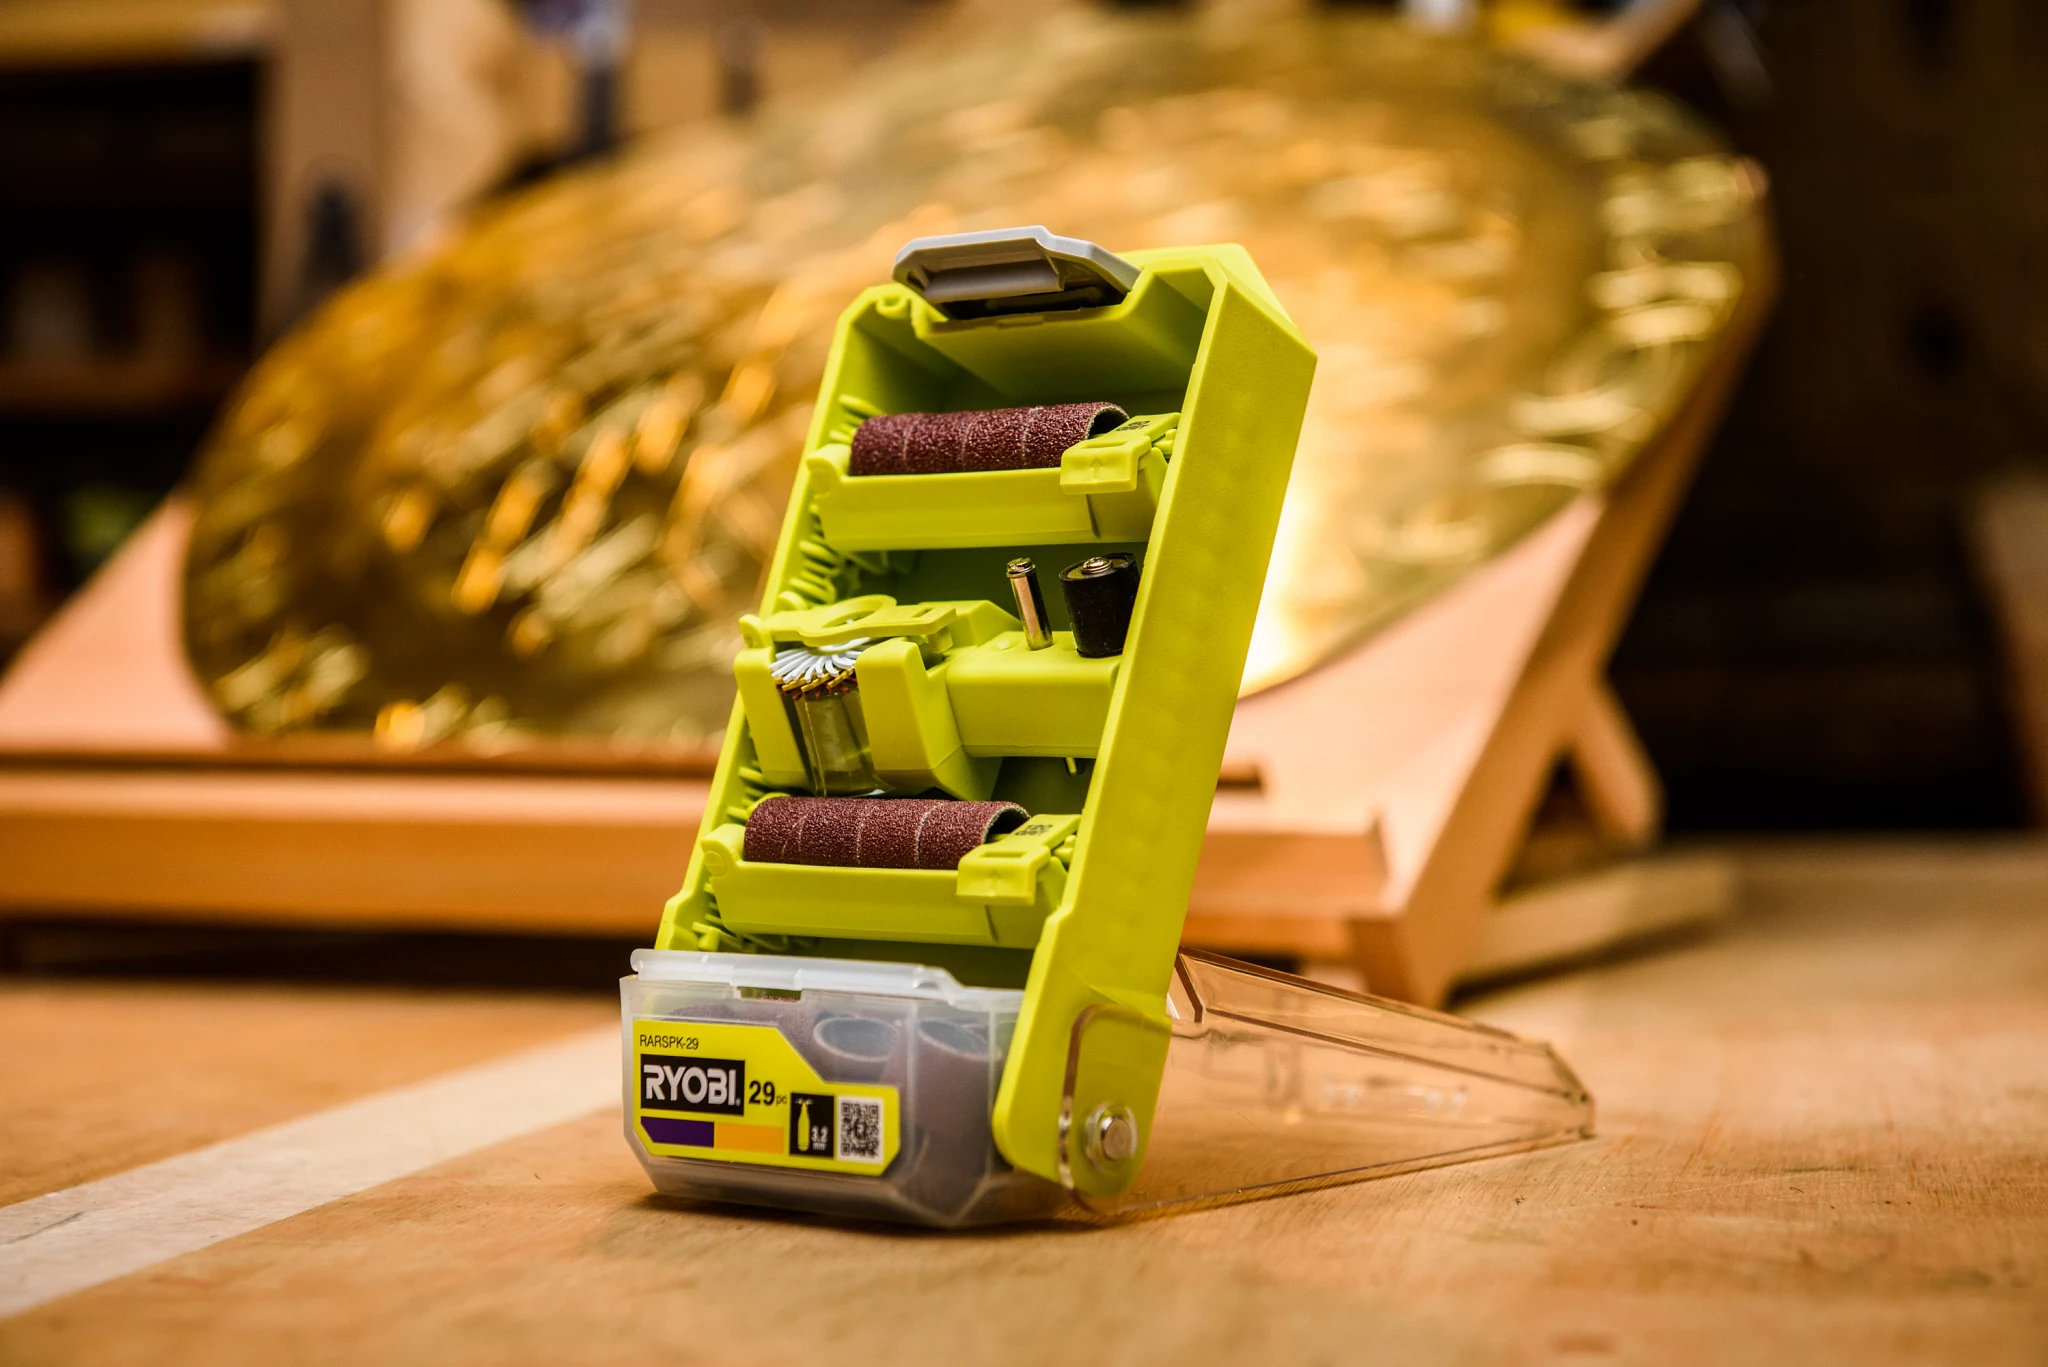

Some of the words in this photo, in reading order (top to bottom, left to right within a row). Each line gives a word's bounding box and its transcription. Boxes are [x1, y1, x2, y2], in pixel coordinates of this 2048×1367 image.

[640, 1034, 699, 1050] RARSPK-29
[643, 1064, 738, 1106] RYOBI
[811, 1125, 829, 1142] 3.2
